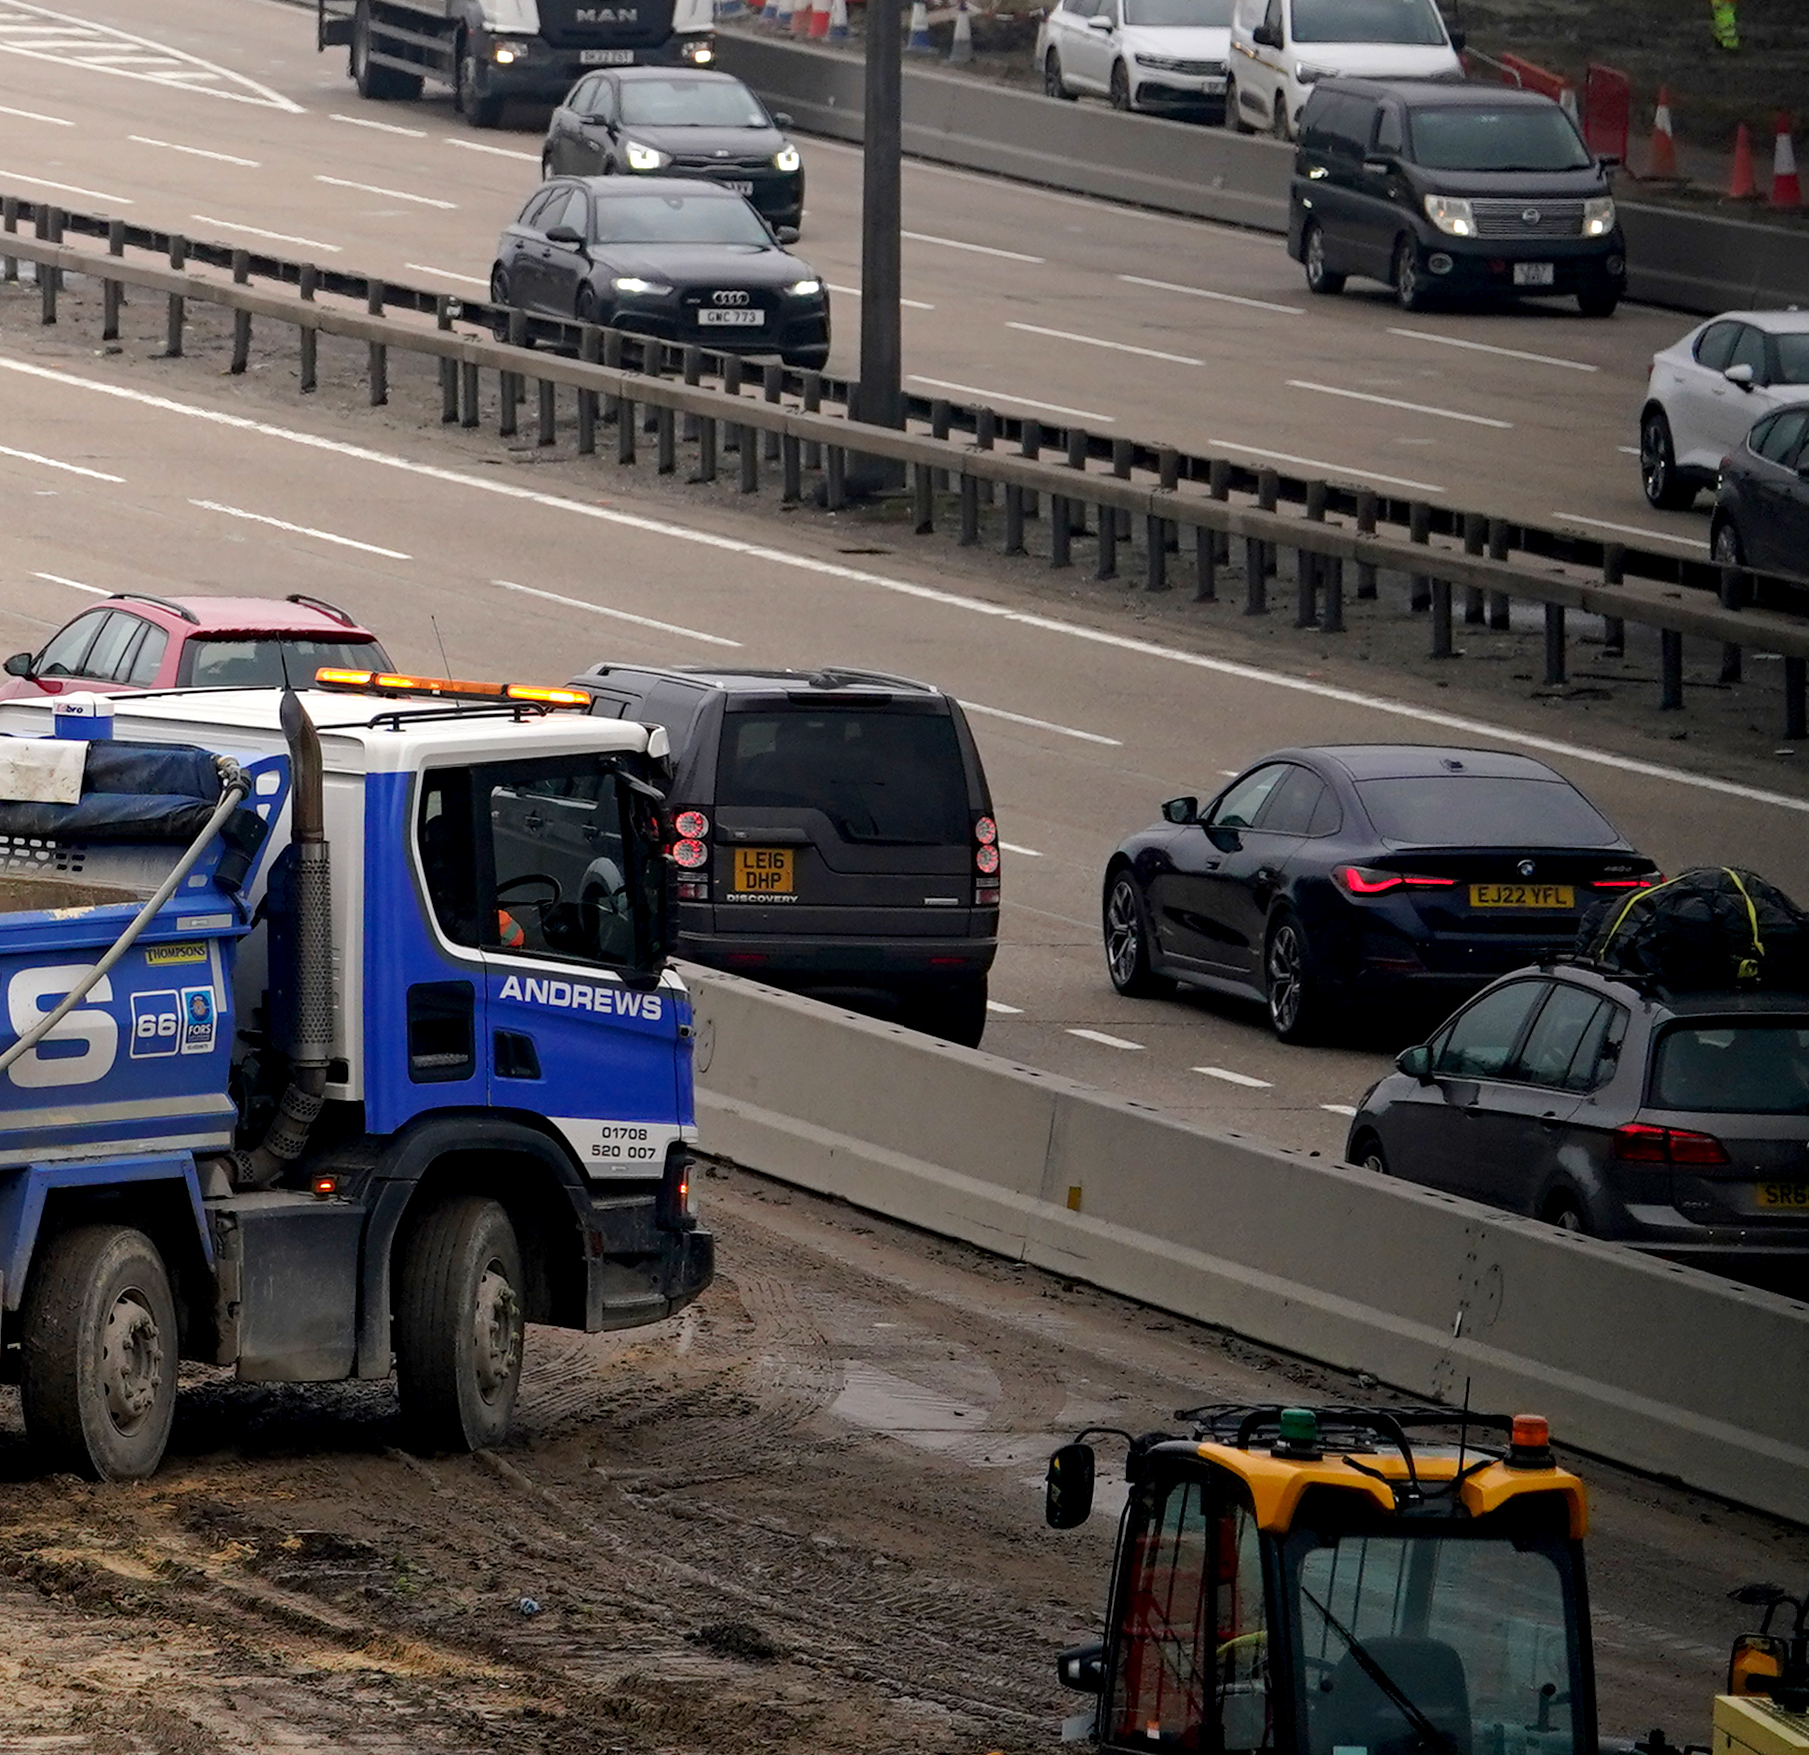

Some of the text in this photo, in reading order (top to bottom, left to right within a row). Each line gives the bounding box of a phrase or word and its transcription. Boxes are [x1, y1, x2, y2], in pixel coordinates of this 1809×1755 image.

[576, 8, 639, 23] MAN
[734, 311, 756, 323] 773
[743, 851, 785, 869] LE16
[746, 871, 782, 889] DHP
[726, 894, 799, 903] DISCOVERY
[1478, 886, 1567, 905] EJ22 YFL
[147, 945, 206, 962] THOMPSONS
[498, 975, 663, 1021] ANDREWS
[137, 1012, 178, 1038] 66
[188, 1023, 212, 1036] FORS
[602, 1127, 648, 1141] 01708
[591, 1144, 656, 1160] 520 007
